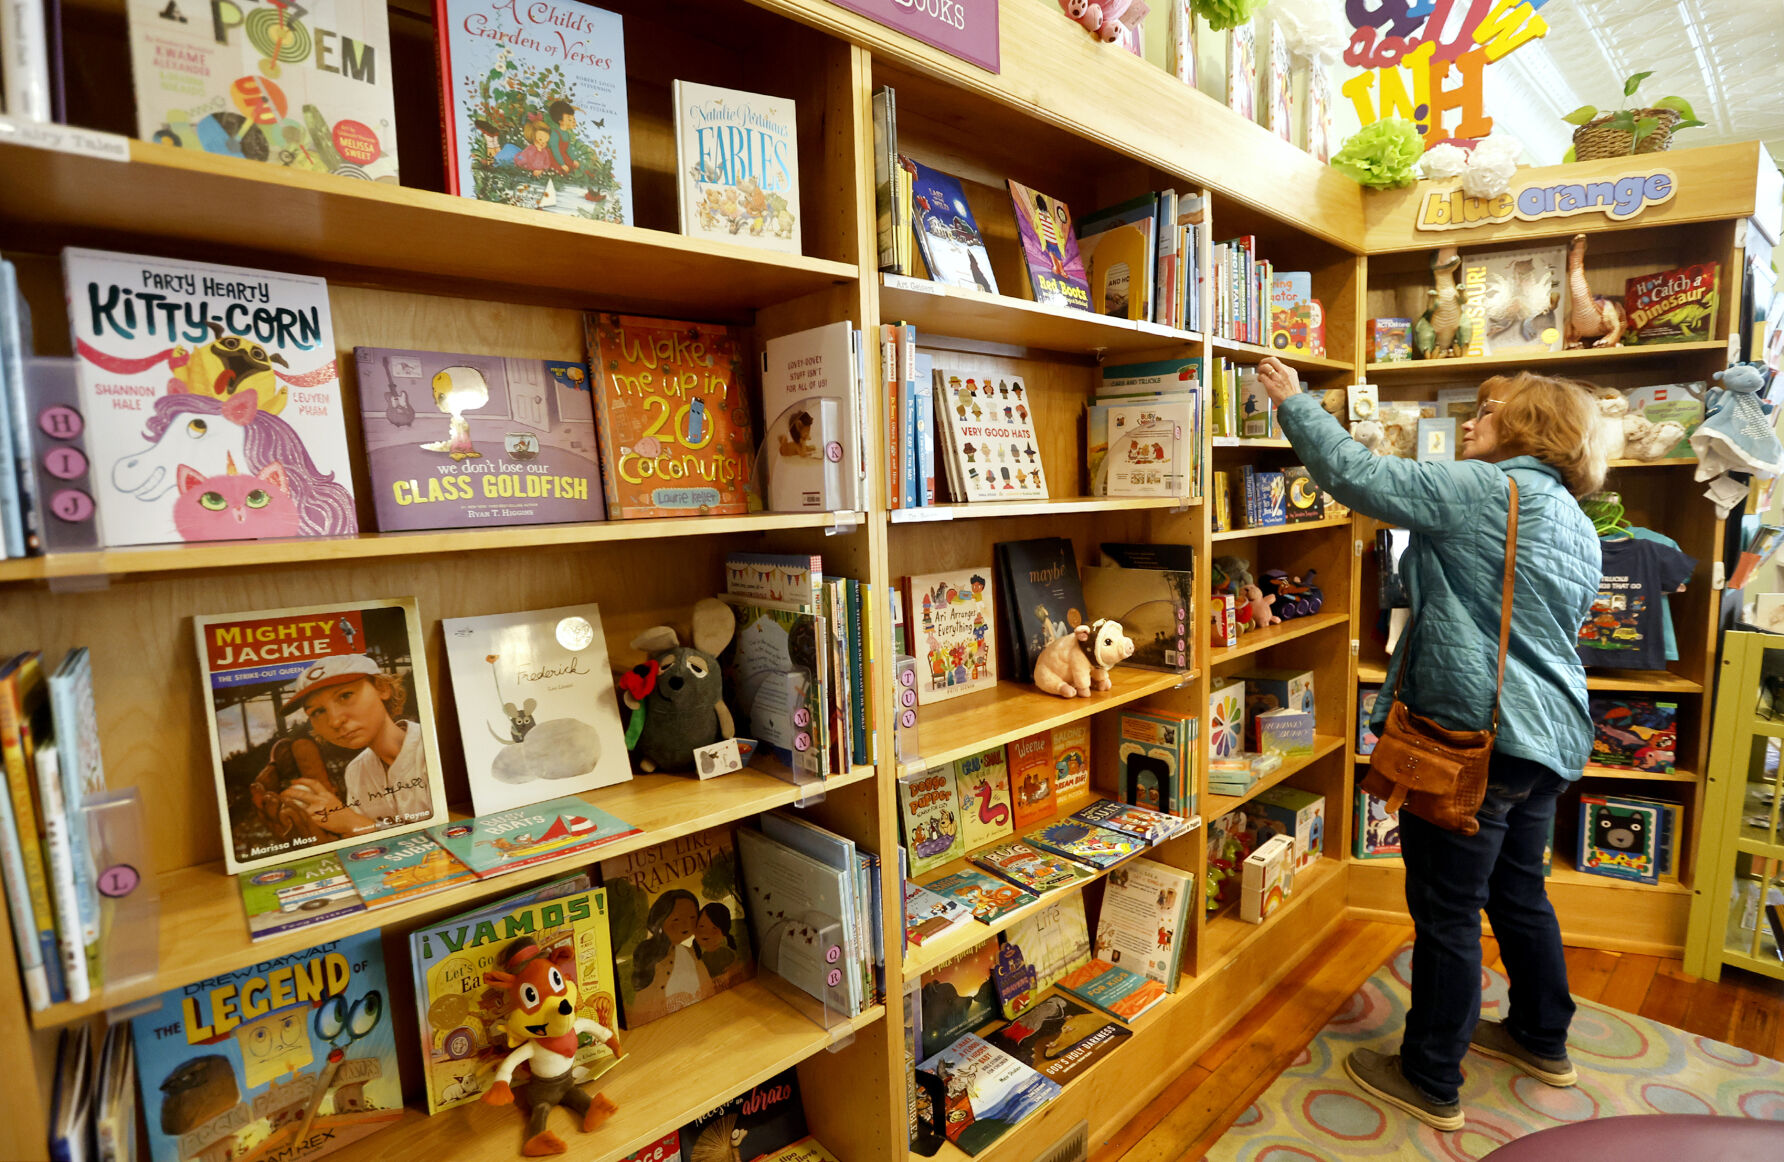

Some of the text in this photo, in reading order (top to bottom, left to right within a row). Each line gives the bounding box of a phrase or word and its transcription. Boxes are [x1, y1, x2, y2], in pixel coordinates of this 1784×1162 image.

[492, 0, 595, 34] A Child's
[463, 13, 613, 71] Garden of Verses
[339, 137, 375, 153] MELISSA
[344, 148, 372, 161] SWEET
[696, 125, 792, 192] FABLES
[1517, 173, 1672, 216] orange
[142, 269, 271, 303] PARTY HEARTY
[1038, 274, 1058, 291] Red
[1059, 280, 1089, 302] Boots
[1636, 274, 1664, 296] How
[1636, 274, 1703, 309] to Catch a
[1466, 265, 1487, 358] DINOSAUR!
[1631, 286, 1707, 329] Dinosaur
[616, 327, 709, 371] Wake
[95, 383, 156, 398] SHANNON
[611, 371, 729, 401] me up in
[112, 398, 142, 411] HALE
[50, 414, 71, 433] H
[642, 395, 715, 451] 20
[961, 427, 1031, 439] VERY GOOD HATS
[830, 445, 840, 459] K
[437, 459, 551, 474] we don't lose our
[392, 474, 589, 507] CLASS GOLDFISH
[63, 497, 79, 515] J
[935, 608, 977, 623] Ari Arranges
[216, 619, 335, 648] MIGHTY
[937, 621, 974, 637] Everything
[216, 638, 333, 666] JACKIE
[218, 666, 305, 683] THE STRIKE-OUT QUEEN
[515, 656, 592, 686] Frederick
[904, 673, 913, 684] T
[904, 692, 914, 704] U
[797, 711, 809, 725] M
[904, 713, 913, 724] V
[798, 736, 808, 749] N
[908, 775, 947, 798] Doggo
[383, 809, 431, 827] C. F. Payne
[479, 810, 525, 828] BUSY
[484, 815, 546, 835] BOATS
[250, 841, 291, 858] Marissa
[292, 835, 318, 848] Moss
[983, 844, 1032, 862] BUG
[624, 843, 668, 875] JUST
[111, 873, 128, 893] L
[615, 847, 736, 896] GRANDMA
[1035, 903, 1061, 932] Life
[829, 947, 839, 962] Q
[183, 939, 342, 996] DREW DAYWALT
[445, 955, 494, 984] Let's Go
[829, 970, 840, 985] R
[461, 973, 487, 995] Ea
[1087, 984, 1107, 997] FOR
[1106, 972, 1129, 986] KIDS
[153, 952, 369, 1046] THE LEGEND OF
[1046, 1058, 1070, 1075] GOD'S
[1066, 1047, 1085, 1061] HOLY
[1082, 1025, 1117, 1050] DARKNESS
[742, 1084, 792, 1116] abrazo
[908, 1100, 918, 1135] BIBLE
[297, 1128, 336, 1153] REX
